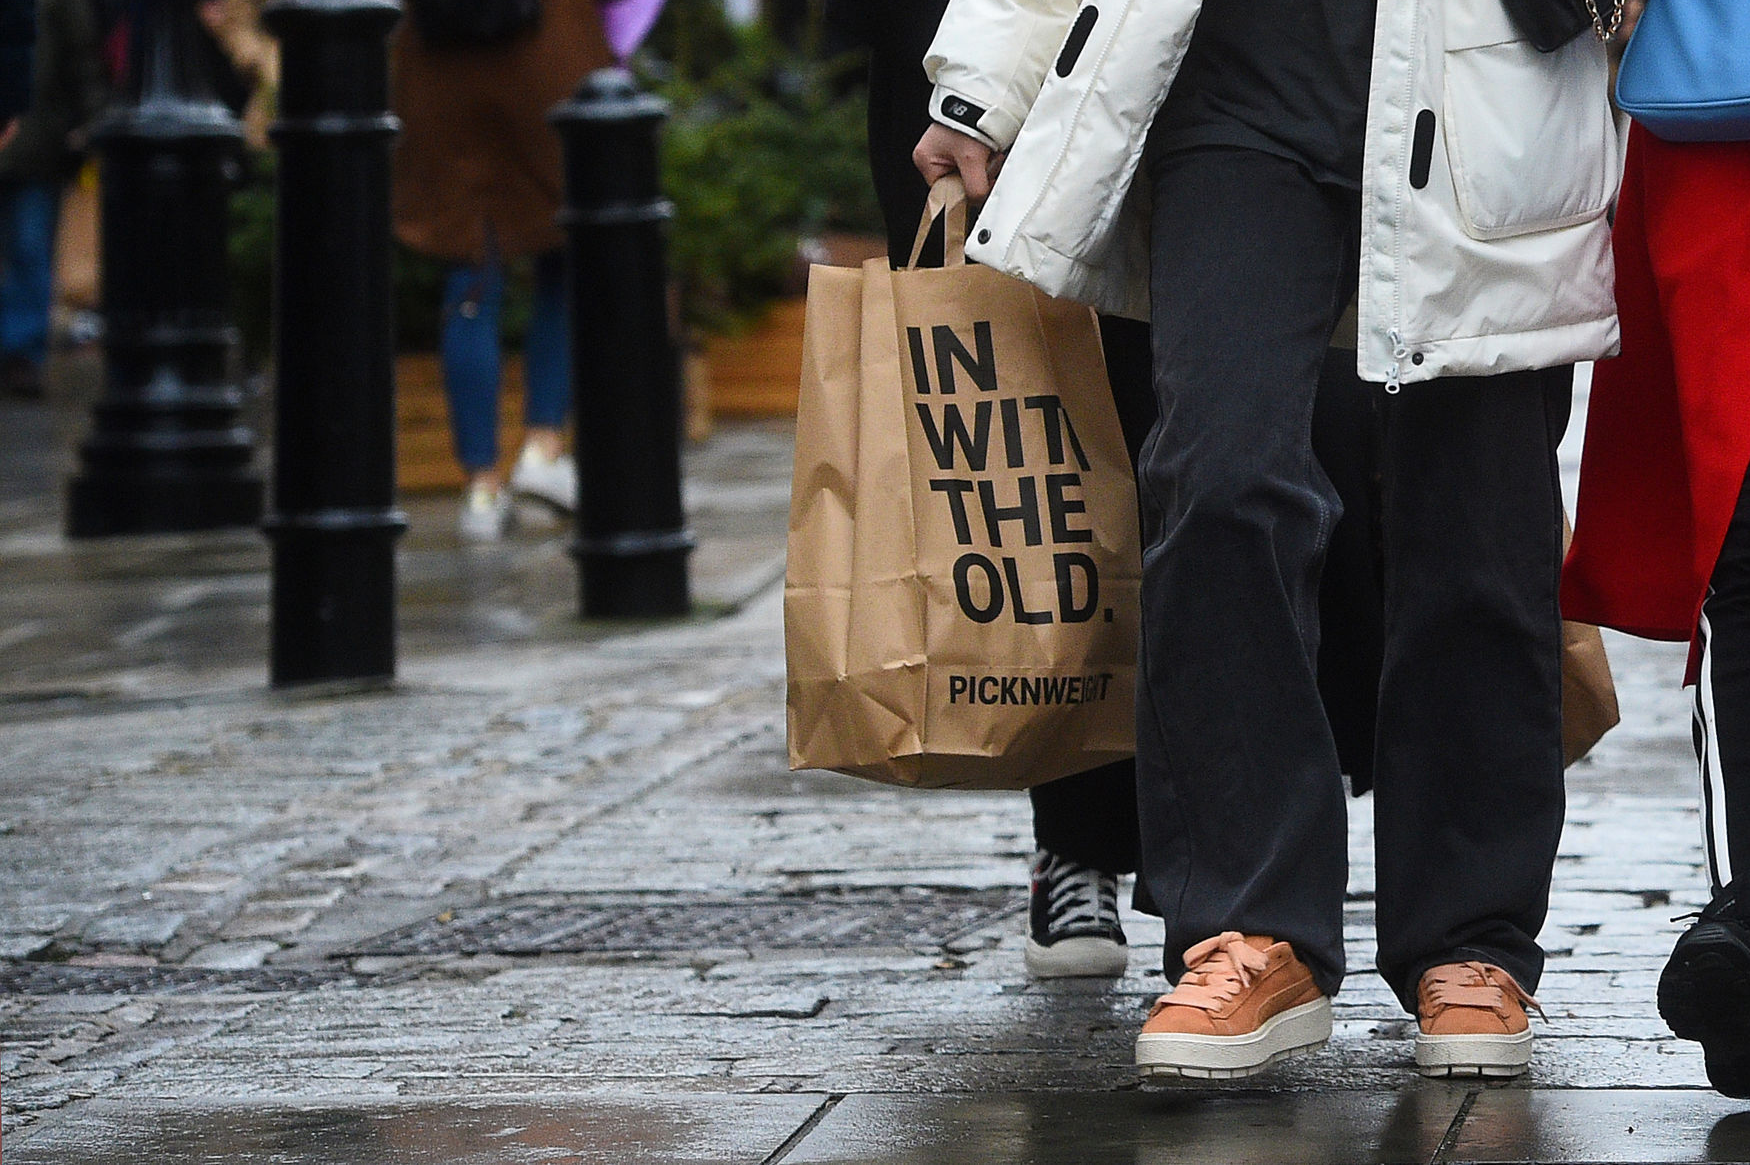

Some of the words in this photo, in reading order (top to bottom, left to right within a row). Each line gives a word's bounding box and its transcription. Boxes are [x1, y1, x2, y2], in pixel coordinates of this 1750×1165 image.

[906, 321, 998, 394] IN
[929, 473, 1092, 547] THE
[953, 552, 1113, 624] OLD.
